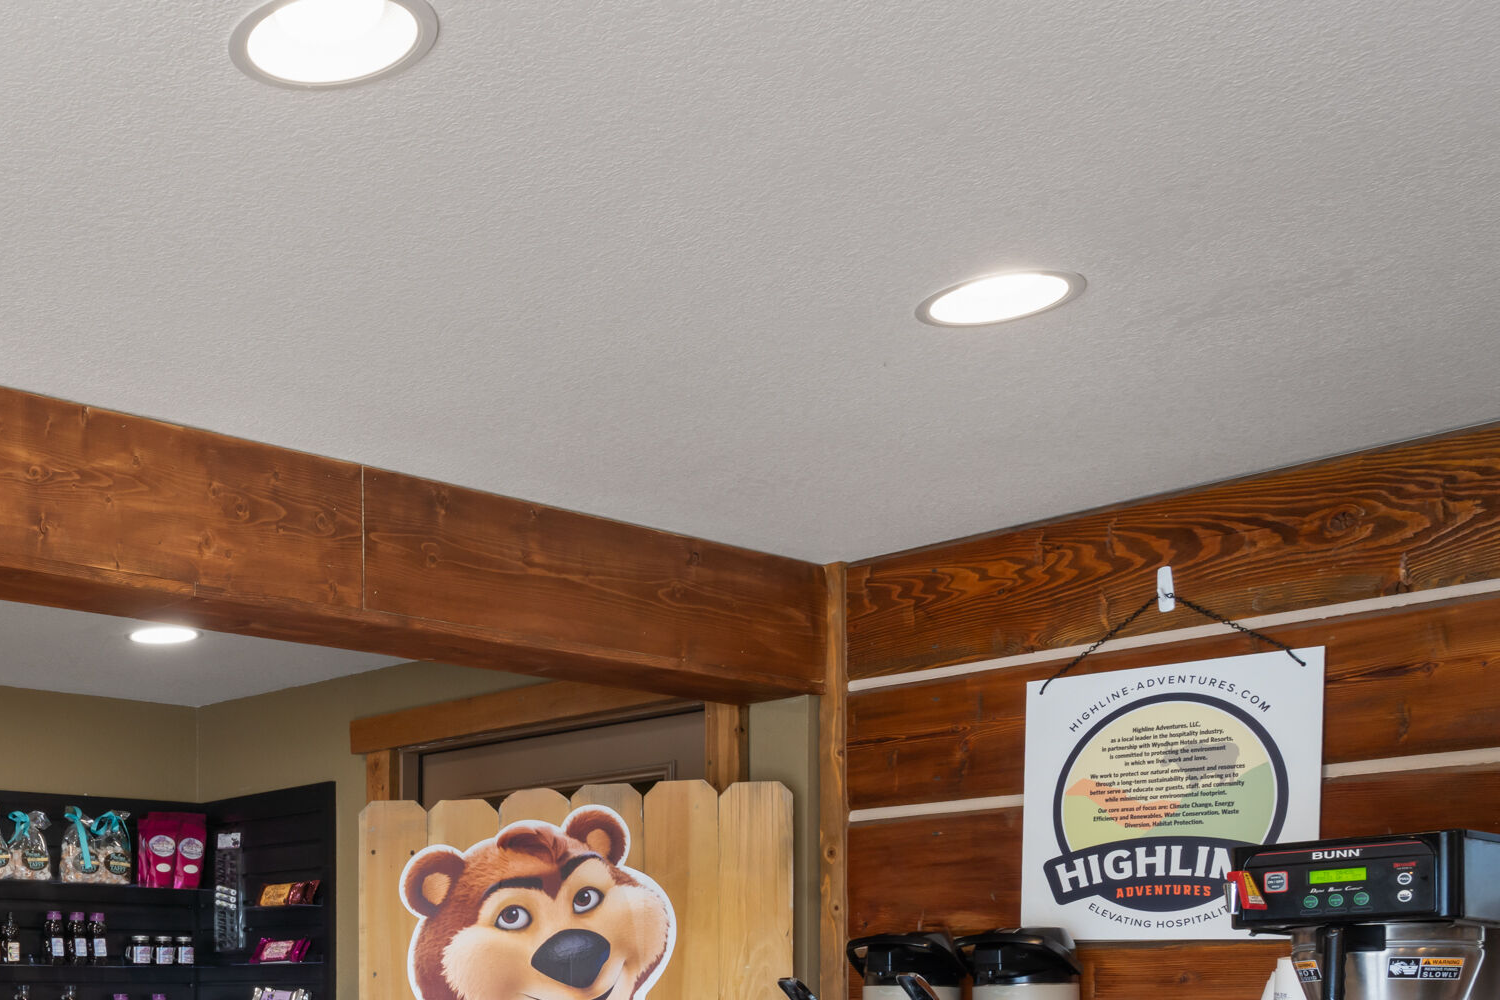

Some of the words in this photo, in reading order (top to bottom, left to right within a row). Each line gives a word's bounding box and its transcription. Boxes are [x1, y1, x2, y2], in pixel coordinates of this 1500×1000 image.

[1069, 674, 1272, 733] HIGHLINE-ADVENTURES.COM
[1312, 848, 1361, 860] BUNN
[1054, 845, 1232, 893] HIGHLIN
[1116, 884, 1212, 899] ADVENTURES
[1088, 902, 1152, 928] ELEVATING
[1156, 904, 1229, 929] HOSPITALIT
